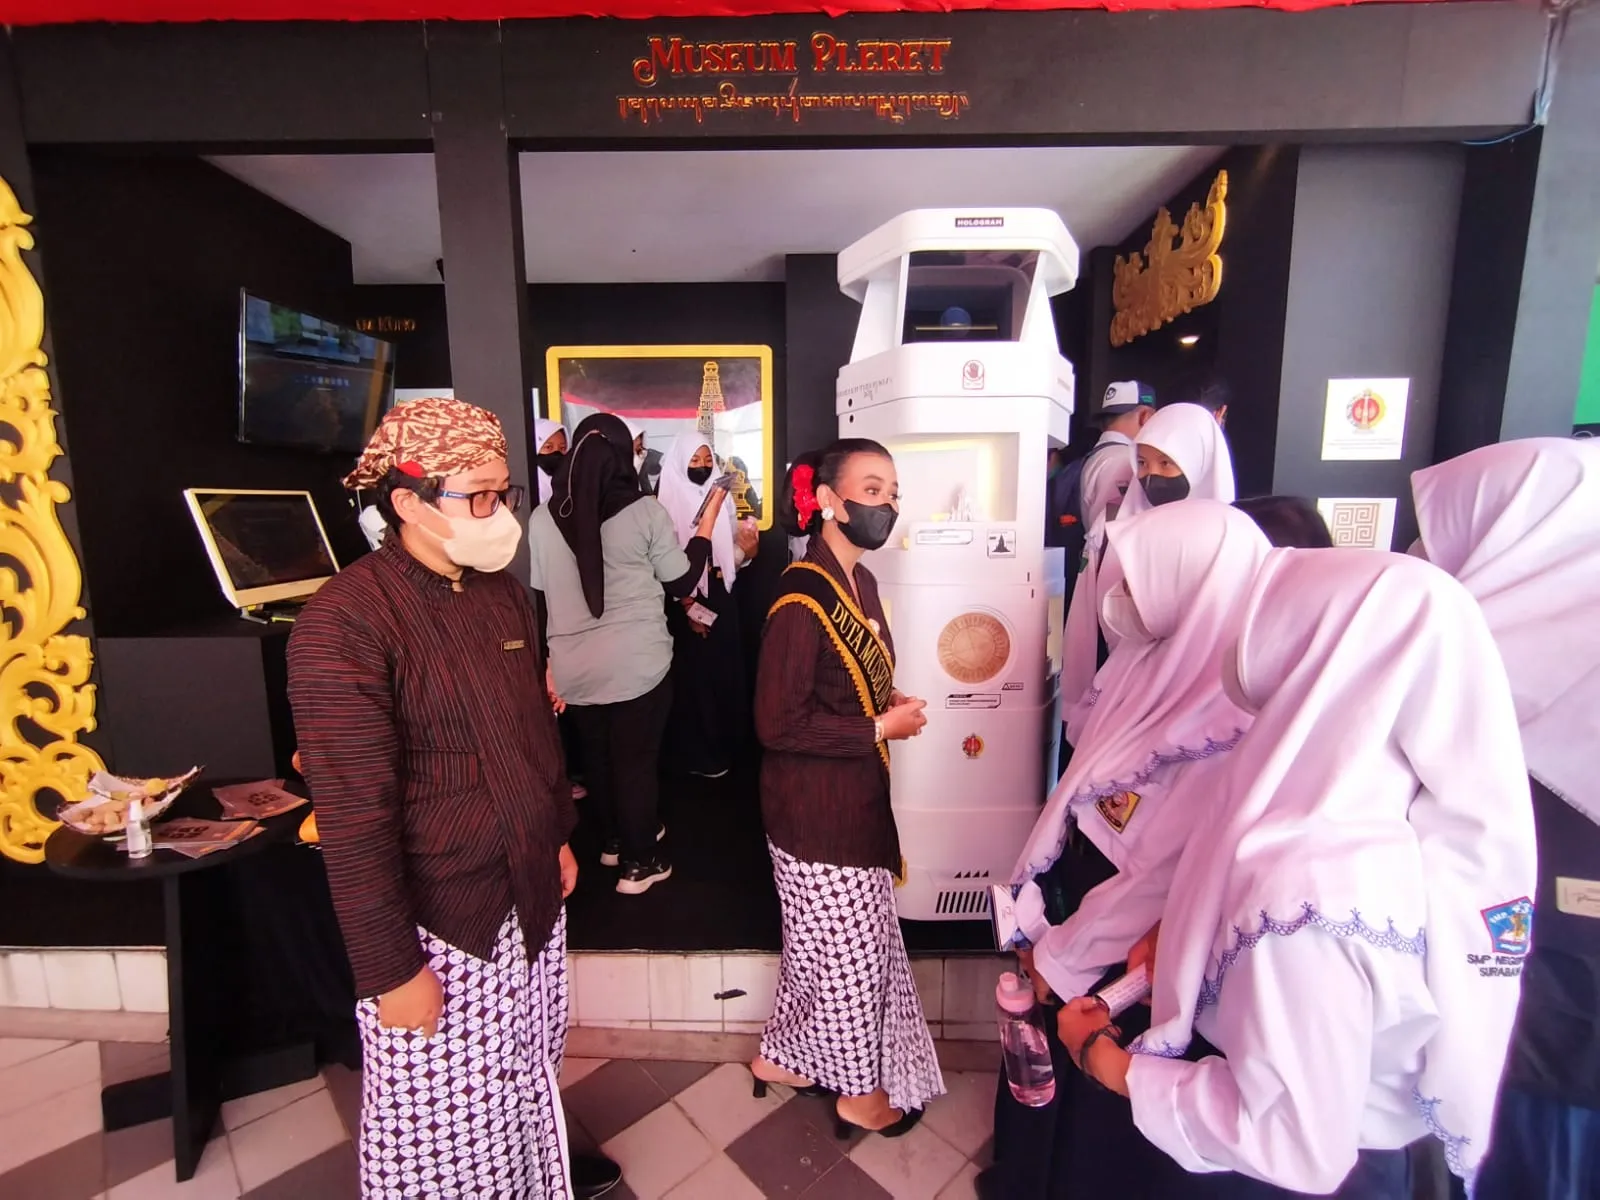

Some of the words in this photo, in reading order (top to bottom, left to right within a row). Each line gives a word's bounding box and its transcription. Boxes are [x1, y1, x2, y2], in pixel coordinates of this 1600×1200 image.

[957, 218, 1003, 227] HOLOGRAM
[830, 600, 865, 652] DUTA
[1466, 953, 1492, 965] SMP
